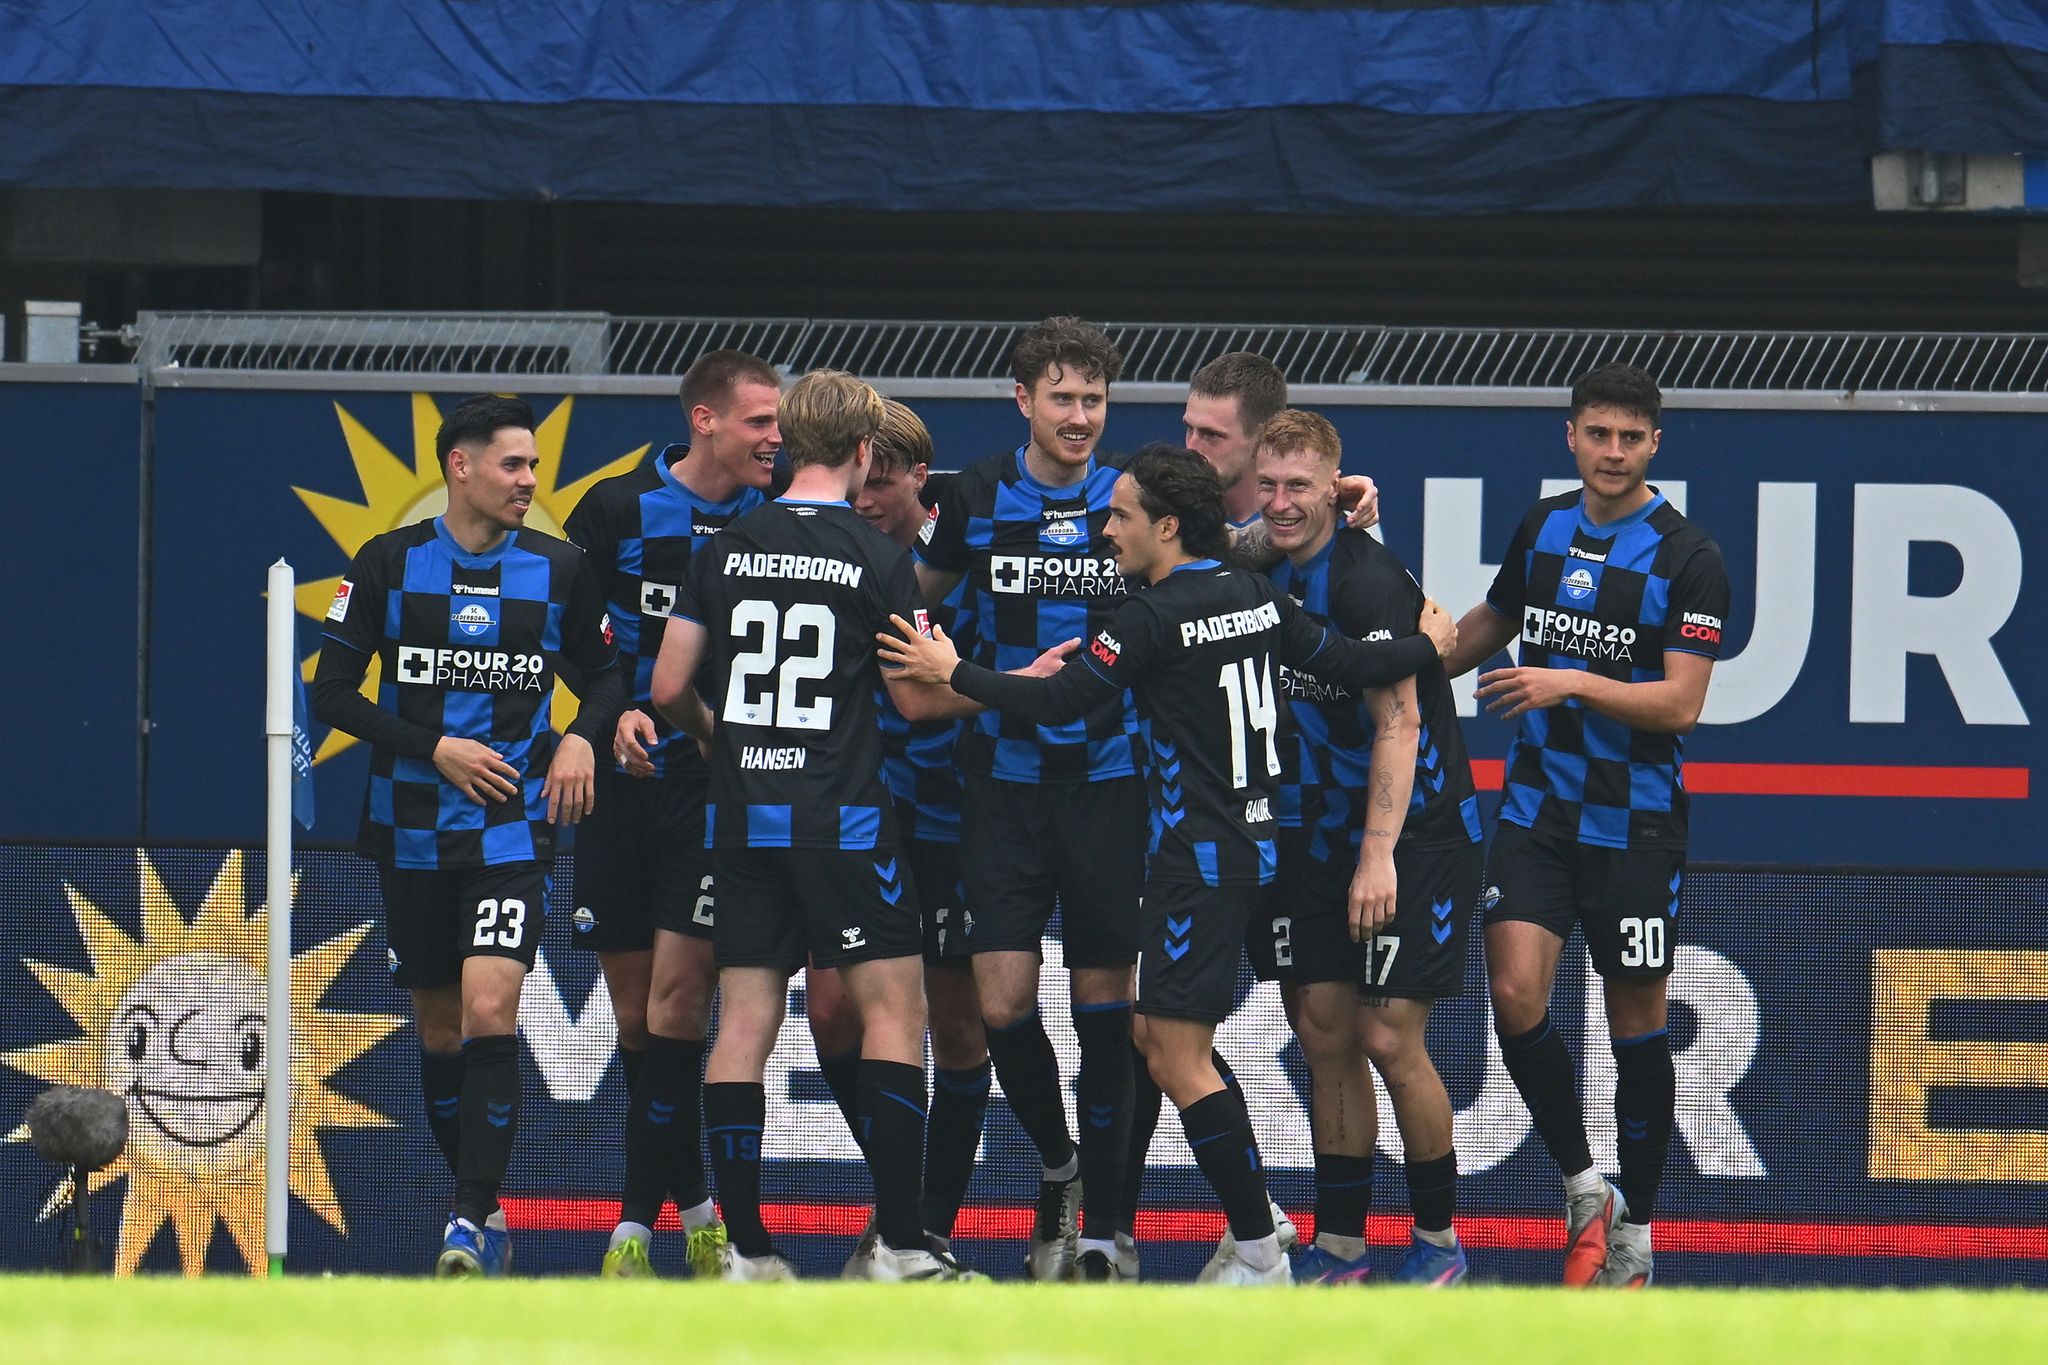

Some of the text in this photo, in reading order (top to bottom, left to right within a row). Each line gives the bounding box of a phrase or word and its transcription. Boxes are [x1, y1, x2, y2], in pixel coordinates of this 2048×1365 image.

[1053, 508, 1087, 519] hummel
[723, 552, 863, 589] PADERBORN
[1028, 557, 1121, 577] FOUR 2
[463, 584, 499, 596] hummel
[1027, 577, 1127, 595] PHARMA
[1544, 609, 1637, 645] FOUR 20
[1542, 629, 1633, 663] PHARMA
[437, 649, 544, 674] FOUR 20
[721, 599, 836, 731] 22
[435, 667, 542, 692] PHARMA
[1218, 651, 1282, 790] 14
[740, 746, 806, 770] HANSEN
[1245, 797, 1273, 823] BAUR
[472, 898, 526, 949] 23
[1619, 917, 1665, 968] 30
[1364, 935, 1400, 986] 17
